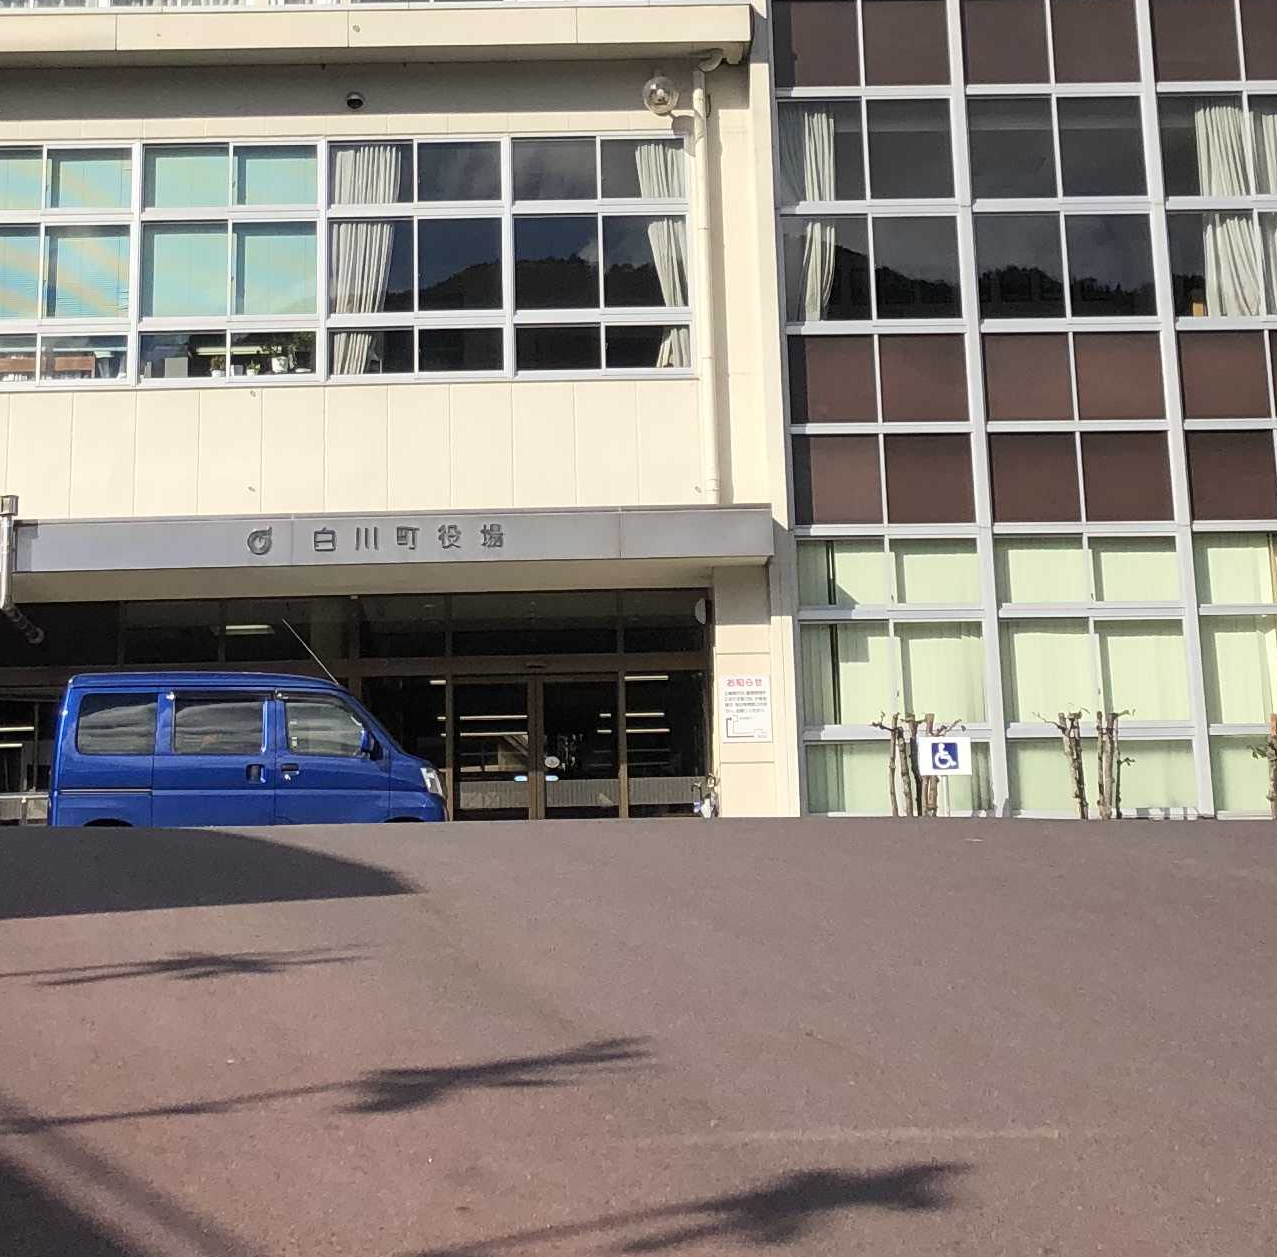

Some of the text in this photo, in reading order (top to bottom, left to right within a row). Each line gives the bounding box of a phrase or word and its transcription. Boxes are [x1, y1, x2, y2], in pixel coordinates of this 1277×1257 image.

[313, 524, 504, 553] 白川町役場
[725, 678, 763, 687] お知らせ
